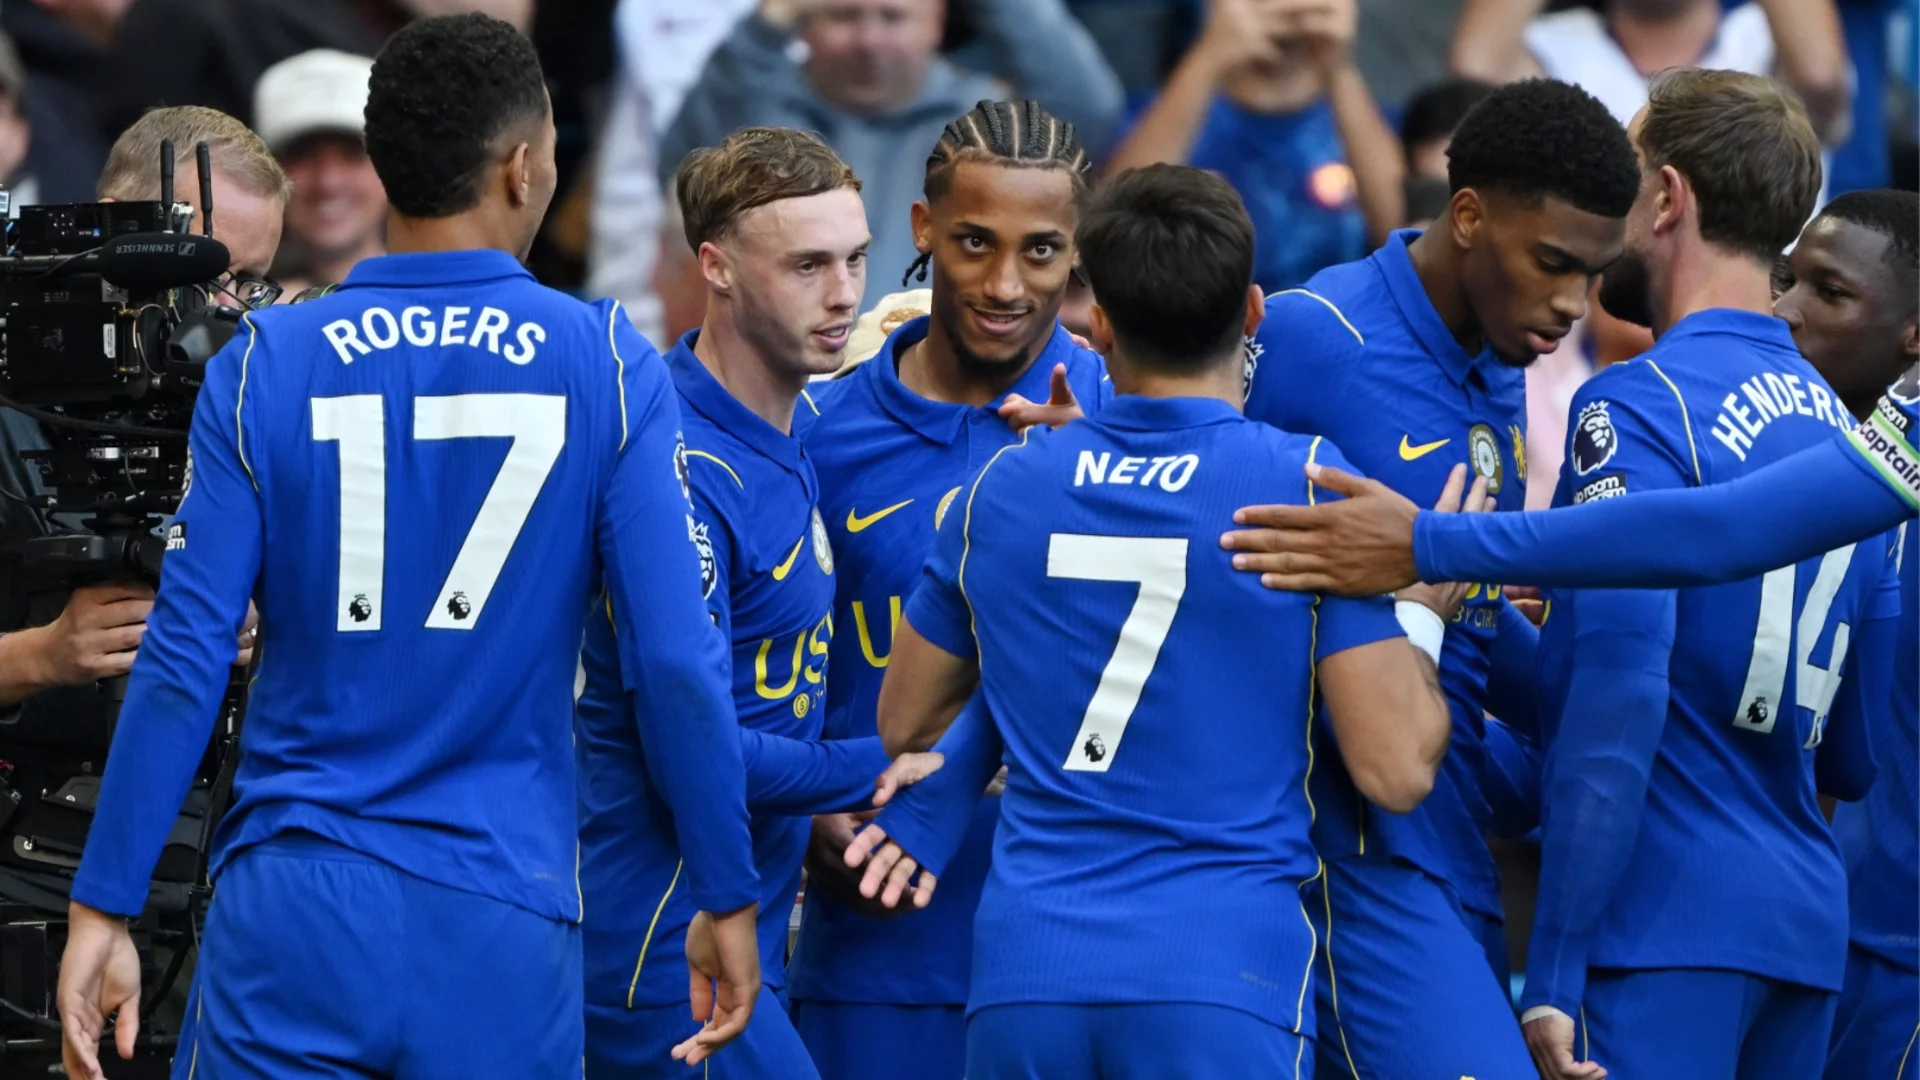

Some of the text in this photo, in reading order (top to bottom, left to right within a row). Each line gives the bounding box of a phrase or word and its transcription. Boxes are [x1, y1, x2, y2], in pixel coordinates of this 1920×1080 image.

[116, 244, 176, 255] SENNHEISER
[322, 306, 546, 365] ROGERS
[180, 375, 200, 388] Can
[1711, 372, 1860, 462] HENDERS
[1074, 450, 1199, 493] NETO
[1583, 476, 1620, 500] room
[310, 393, 567, 632] 17
[755, 610, 834, 699] US
[1046, 532, 1189, 772] 7
[1732, 542, 1857, 749] 14
